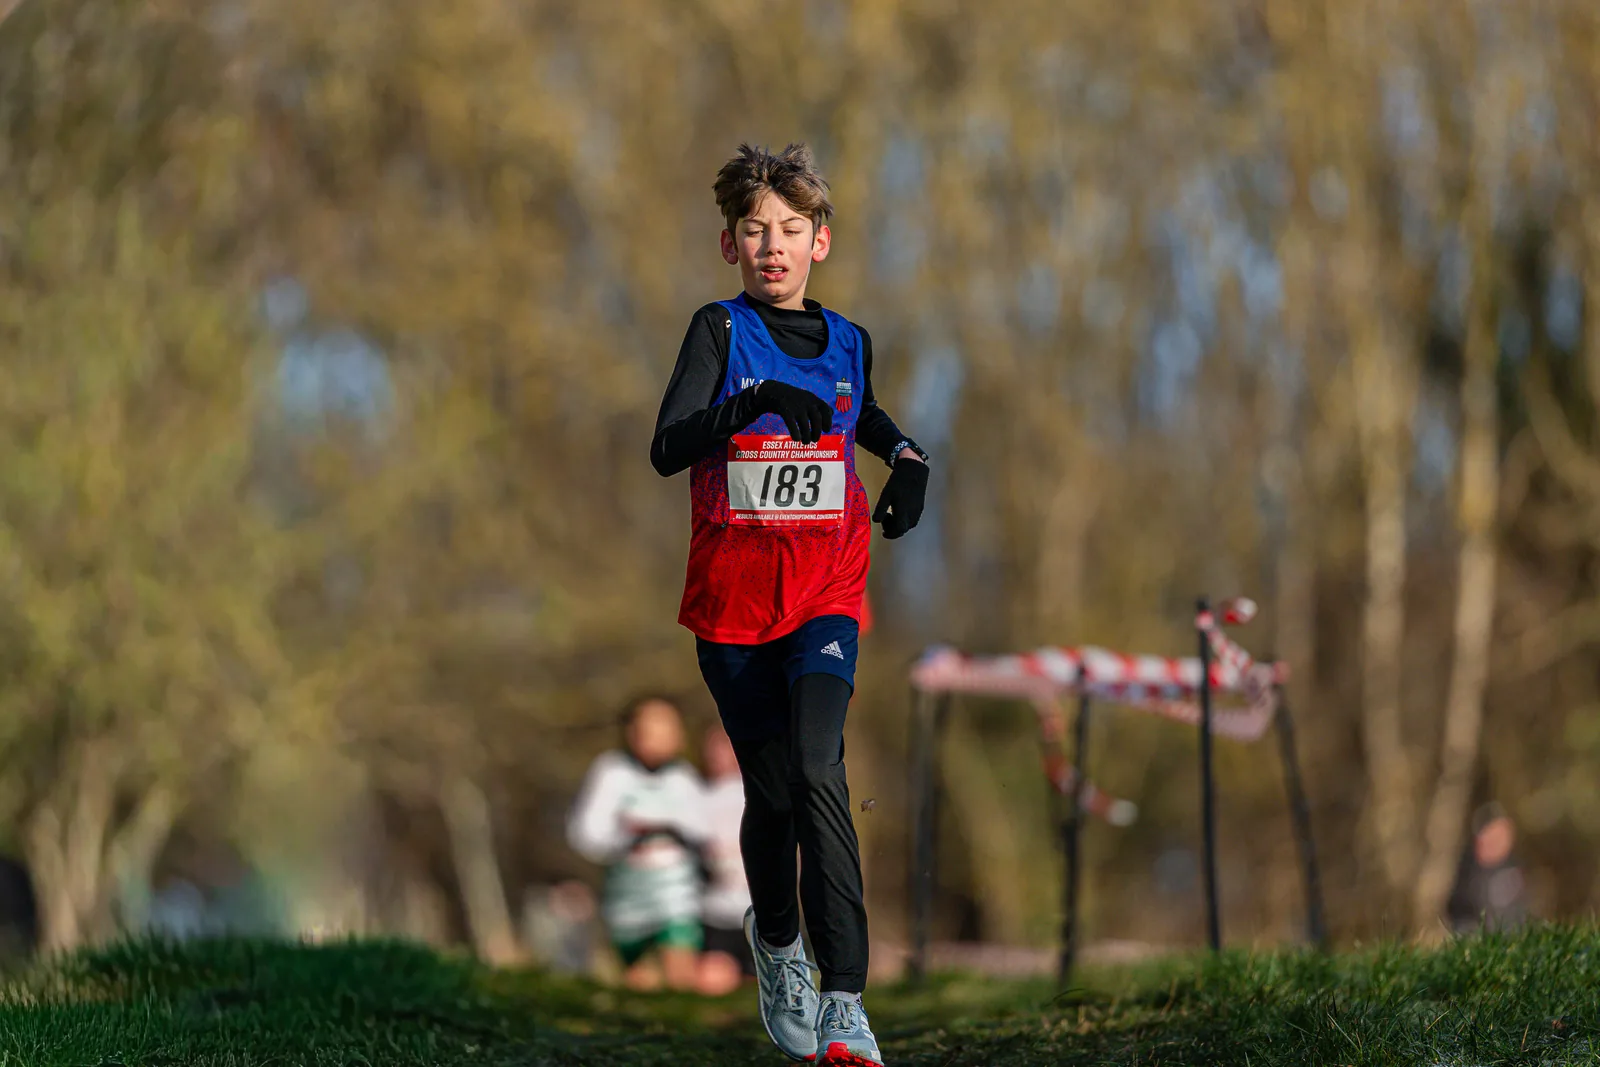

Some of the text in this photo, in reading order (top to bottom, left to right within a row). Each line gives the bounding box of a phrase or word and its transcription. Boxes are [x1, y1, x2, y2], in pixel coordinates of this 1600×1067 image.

[762, 441, 783, 449] ESSEX
[736, 450, 838, 459] CROSS COUNTRY CHAMPIONSHIPS
[759, 464, 822, 507] 183
[820, 648, 844, 660] adidas
